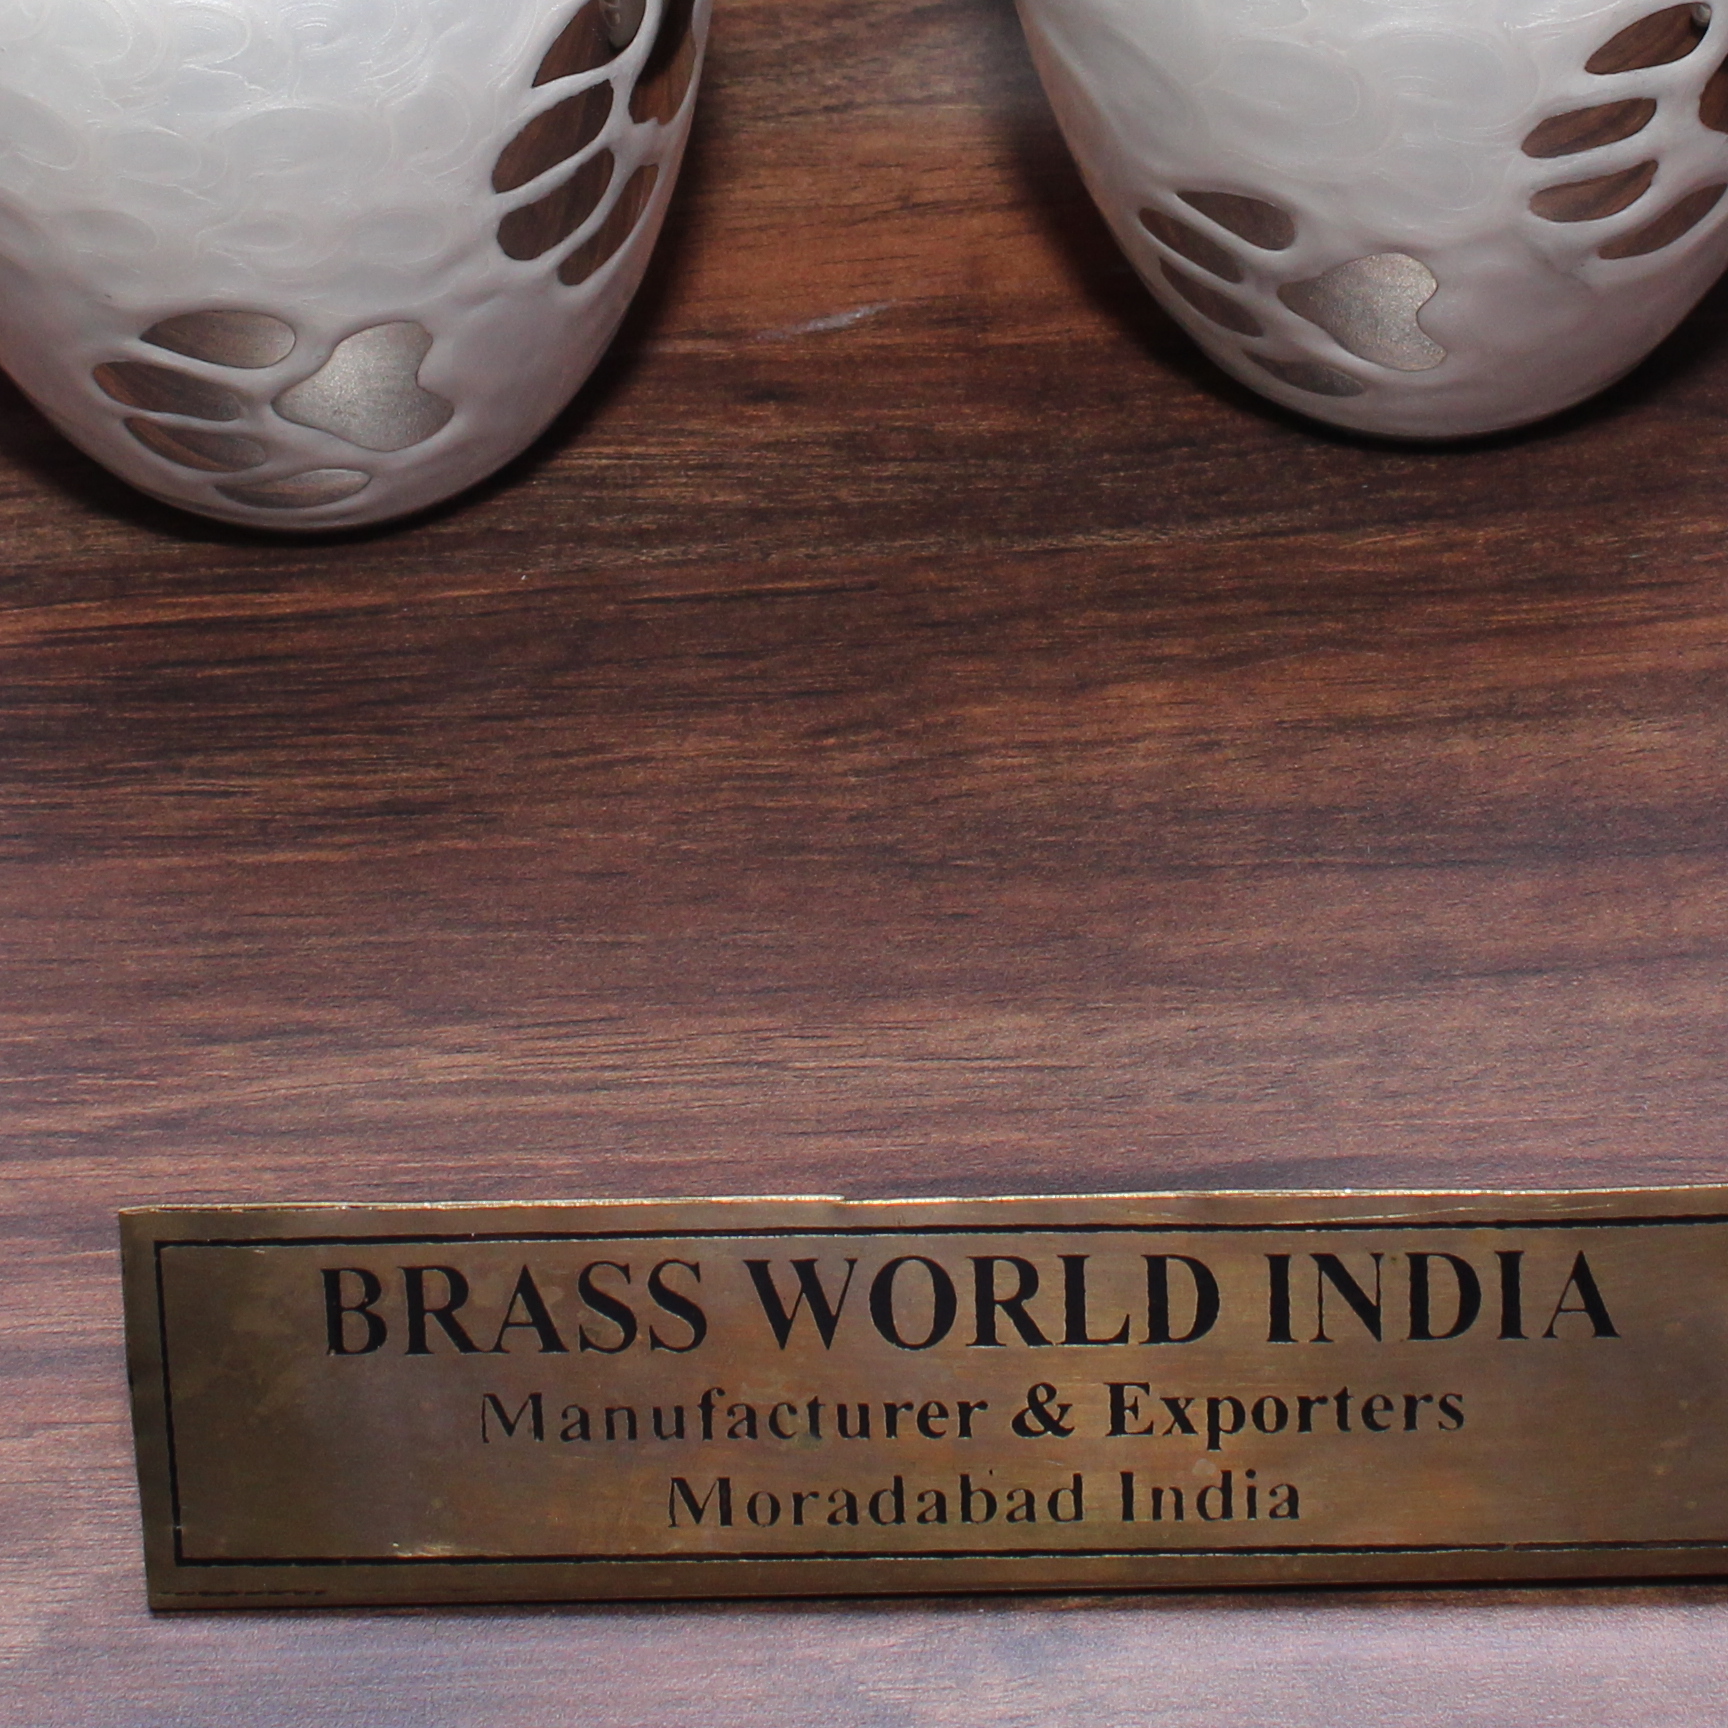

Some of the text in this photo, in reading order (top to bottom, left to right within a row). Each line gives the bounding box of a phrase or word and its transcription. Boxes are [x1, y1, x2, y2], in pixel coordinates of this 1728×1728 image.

[322, 1249, 1620, 1356] BRASS WORLD INDIA
[479, 1382, 1467, 1449] Manufacturer & Exporters
[667, 1469, 1302, 1528] Moradabad India
